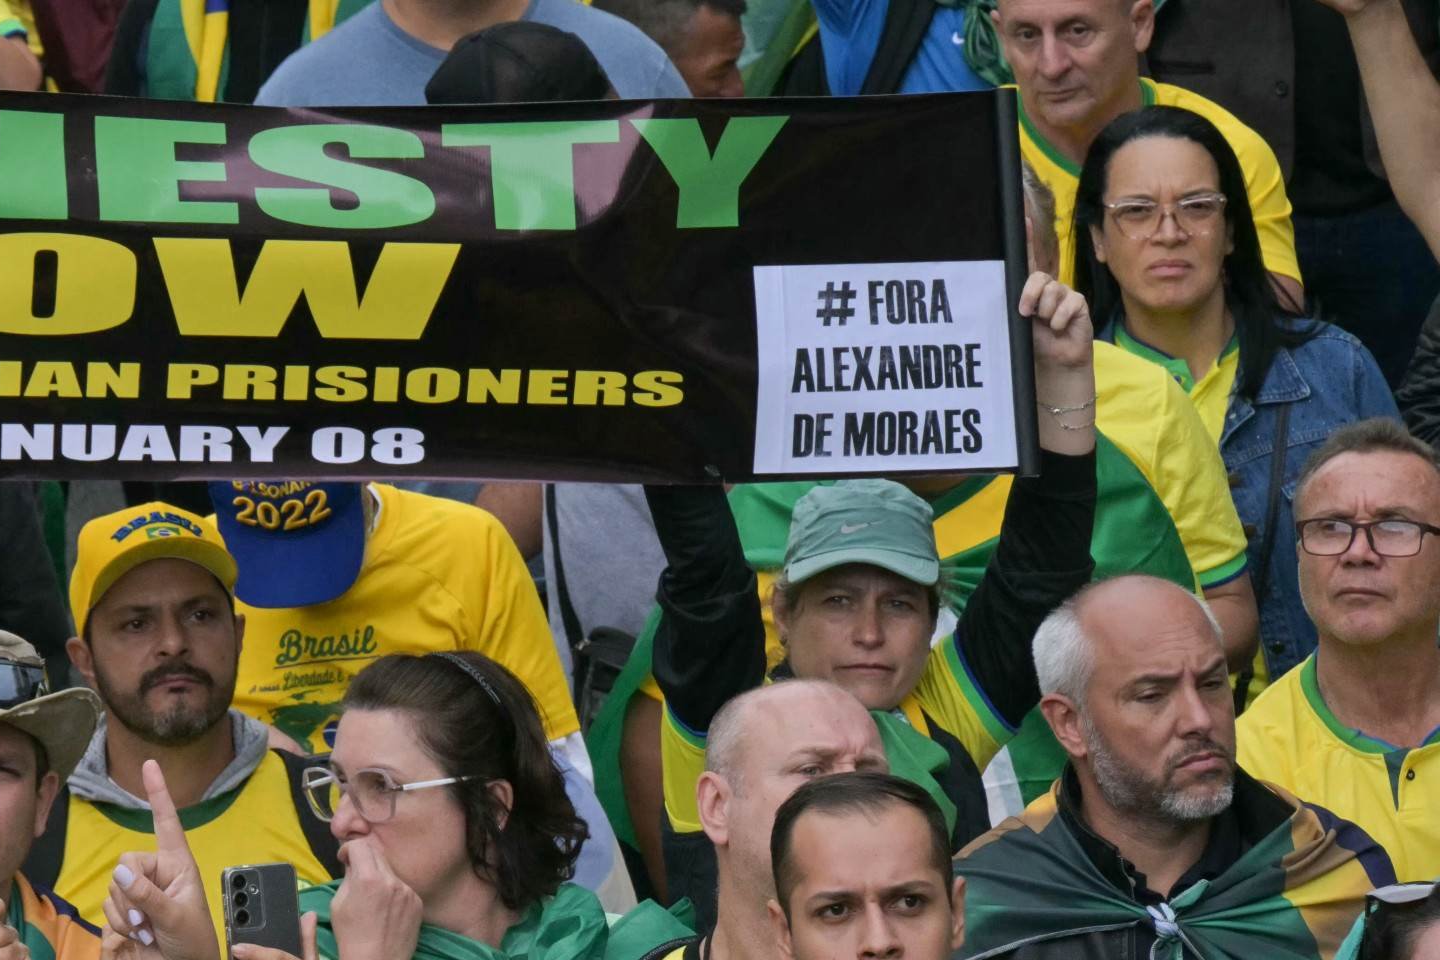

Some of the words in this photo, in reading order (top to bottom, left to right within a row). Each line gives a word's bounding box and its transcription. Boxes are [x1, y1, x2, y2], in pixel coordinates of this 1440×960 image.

[867, 279, 953, 325] FORA
[166, 363, 685, 407] PRISIONERS
[791, 343, 984, 393] ALEXANDRE
[311, 425, 426, 464] 08
[791, 412, 835, 458] DE
[843, 408, 984, 457] MORAES
[110, 511, 203, 542] BRASIL
[232, 488, 332, 531] 2022
[275, 624, 378, 665] Brasil
